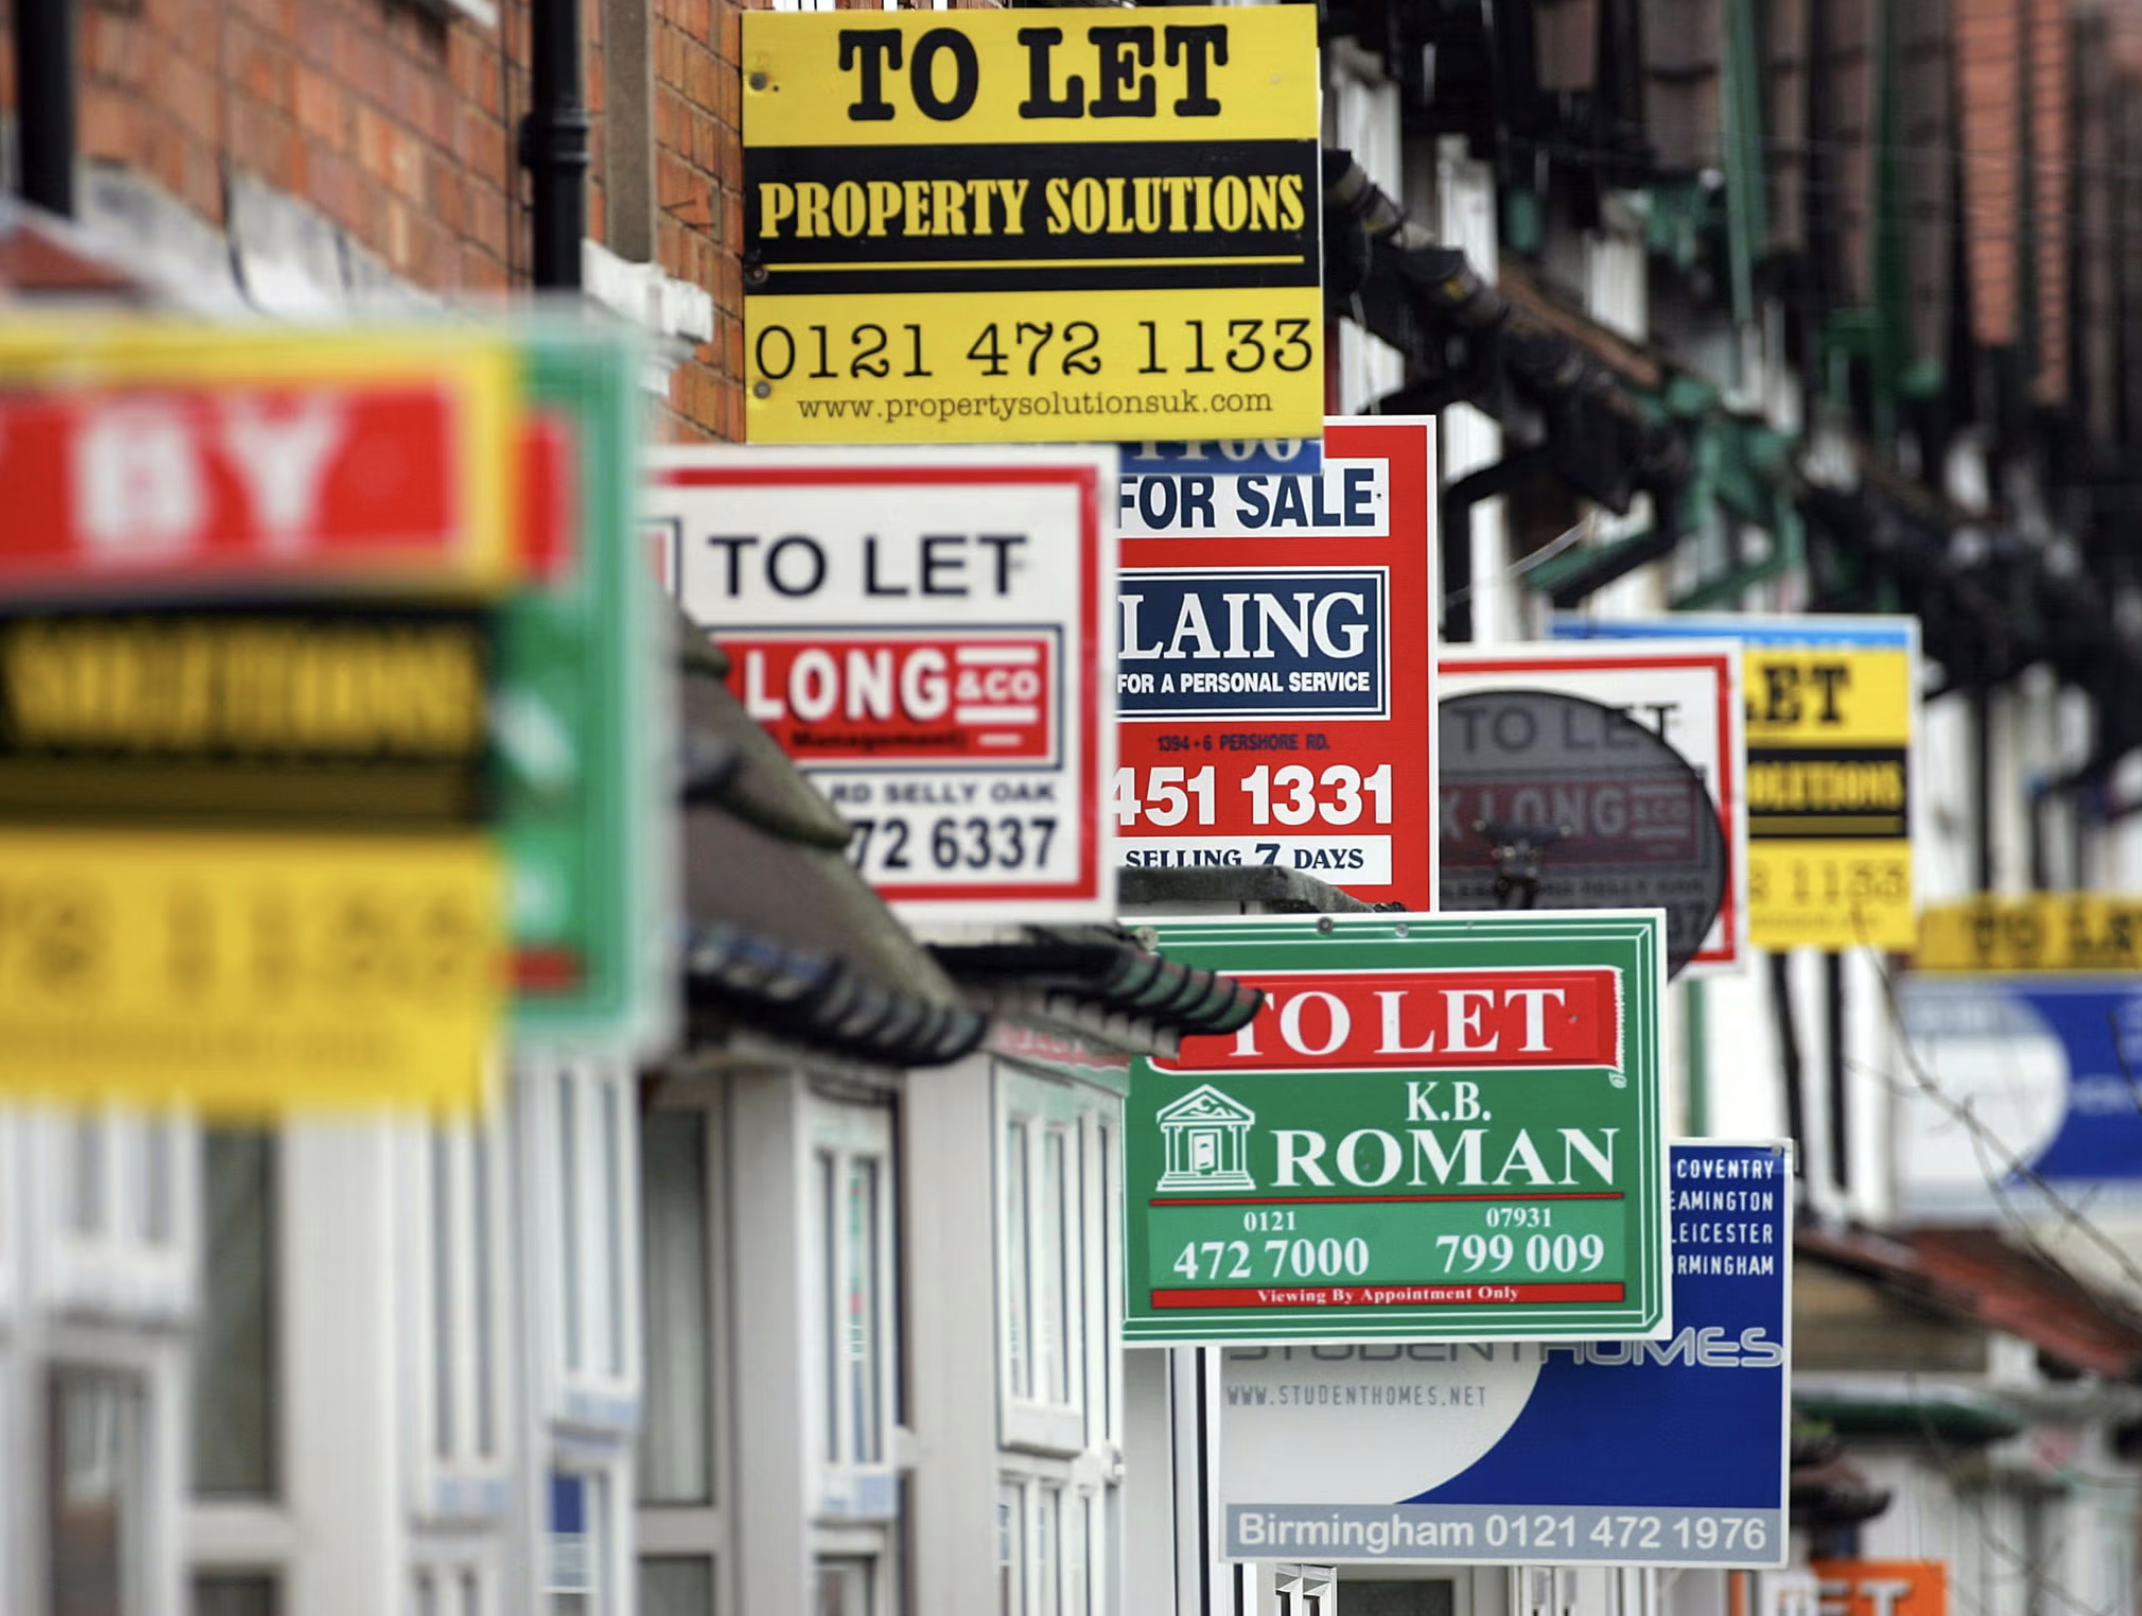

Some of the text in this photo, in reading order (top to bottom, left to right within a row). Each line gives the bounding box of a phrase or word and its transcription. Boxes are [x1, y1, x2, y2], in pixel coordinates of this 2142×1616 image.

[838, 24, 1228, 122] TO LET
[758, 174, 1305, 239] PROPERTY SOLUTIONS
[755, 318, 1313, 380] 0121 472 1133
[797, 388, 1273, 423] www.propertysolutionsuk.com
[70, 395, 345, 562] BY
[1118, 468, 1375, 530] FOR SALE
[708, 535, 1027, 598] TO LET
[1117, 591, 1369, 660] LAING
[745, 648, 1039, 722] LONG &CO
[1117, 671, 1370, 694] FOR A PERSONAL SERVICE
[1746, 664, 1850, 722] ET
[1219, 733, 1299, 751] PERSHORE
[885, 783, 976, 801] SELLY
[990, 782, 1054, 801] OAK
[1112, 764, 1393, 827] 451 1331
[931, 817, 1058, 870] 6337
[1125, 843, 1365, 870] SELLING 7 DAYS
[1229, 989, 1566, 1057] TO LET
[1405, 1081, 1491, 1121] K.B.
[1269, 1128, 1620, 1187] ROMAN
[1676, 1159, 1775, 1180] COVENTRY
[1243, 1207, 1553, 1232] 0121 07931
[1173, 1233, 1605, 1281] 472 7000 799 009
[1257, 1285, 1520, 1306] Viewing By Appointment Only
[1226, 1385, 1487, 1407] WWW.STUDENTHOMES.NET
[1238, 1513, 1767, 1553] Birmingham 0121 472 1976
